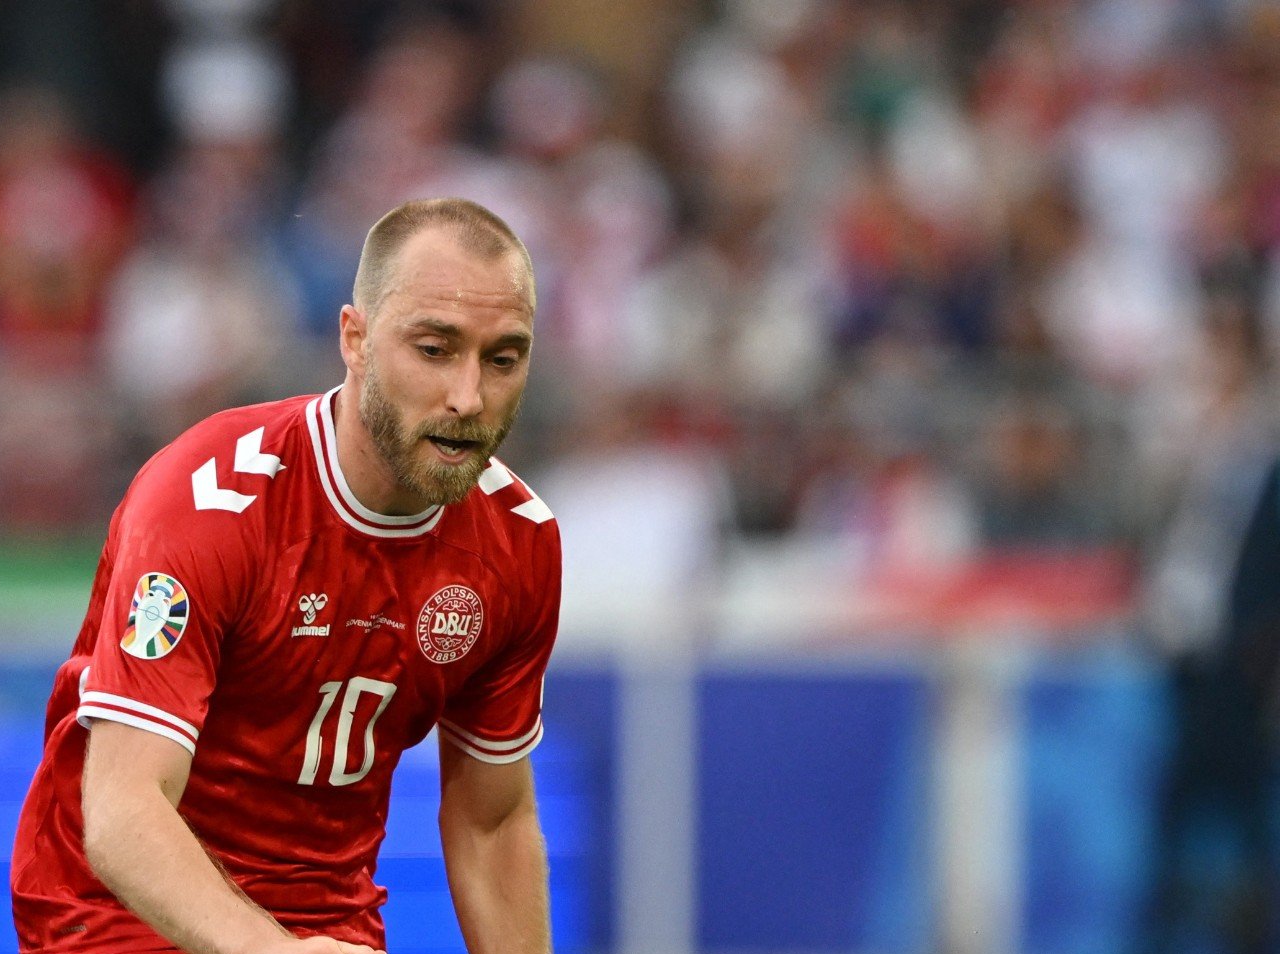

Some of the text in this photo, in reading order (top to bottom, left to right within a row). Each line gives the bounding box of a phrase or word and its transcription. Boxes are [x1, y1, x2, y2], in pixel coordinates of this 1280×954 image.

[420, 605, 435, 651] DANSK
[431, 612, 472, 635] DBU
[431, 651, 457, 661] 1889
[296, 675, 398, 787] 10
